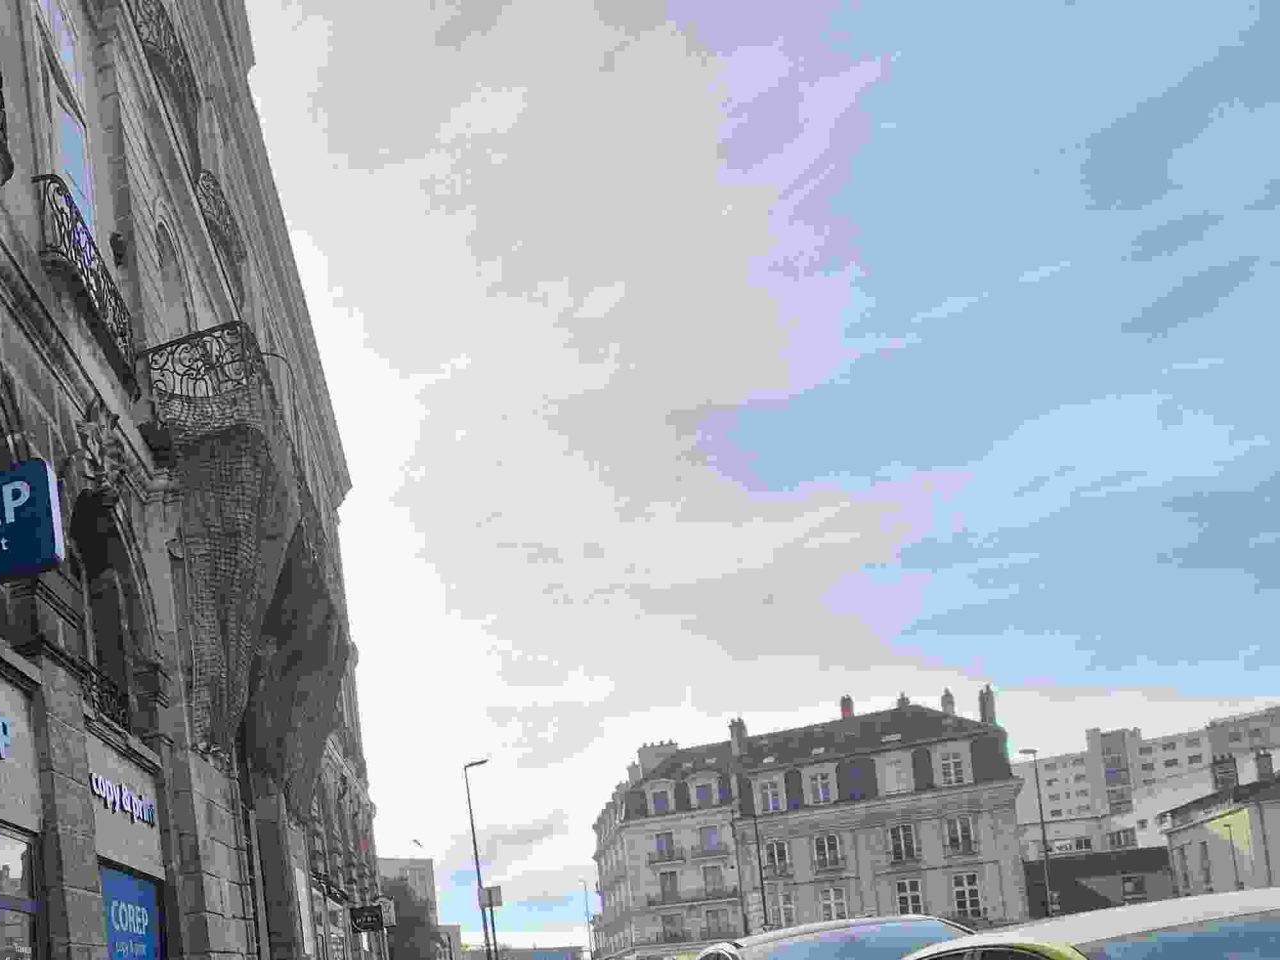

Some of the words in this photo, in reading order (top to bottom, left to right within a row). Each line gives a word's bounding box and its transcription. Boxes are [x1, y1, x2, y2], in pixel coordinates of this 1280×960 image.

[89, 772, 120, 814] copy
[131, 794, 155, 827] print
[111, 899, 149, 935] COREP
